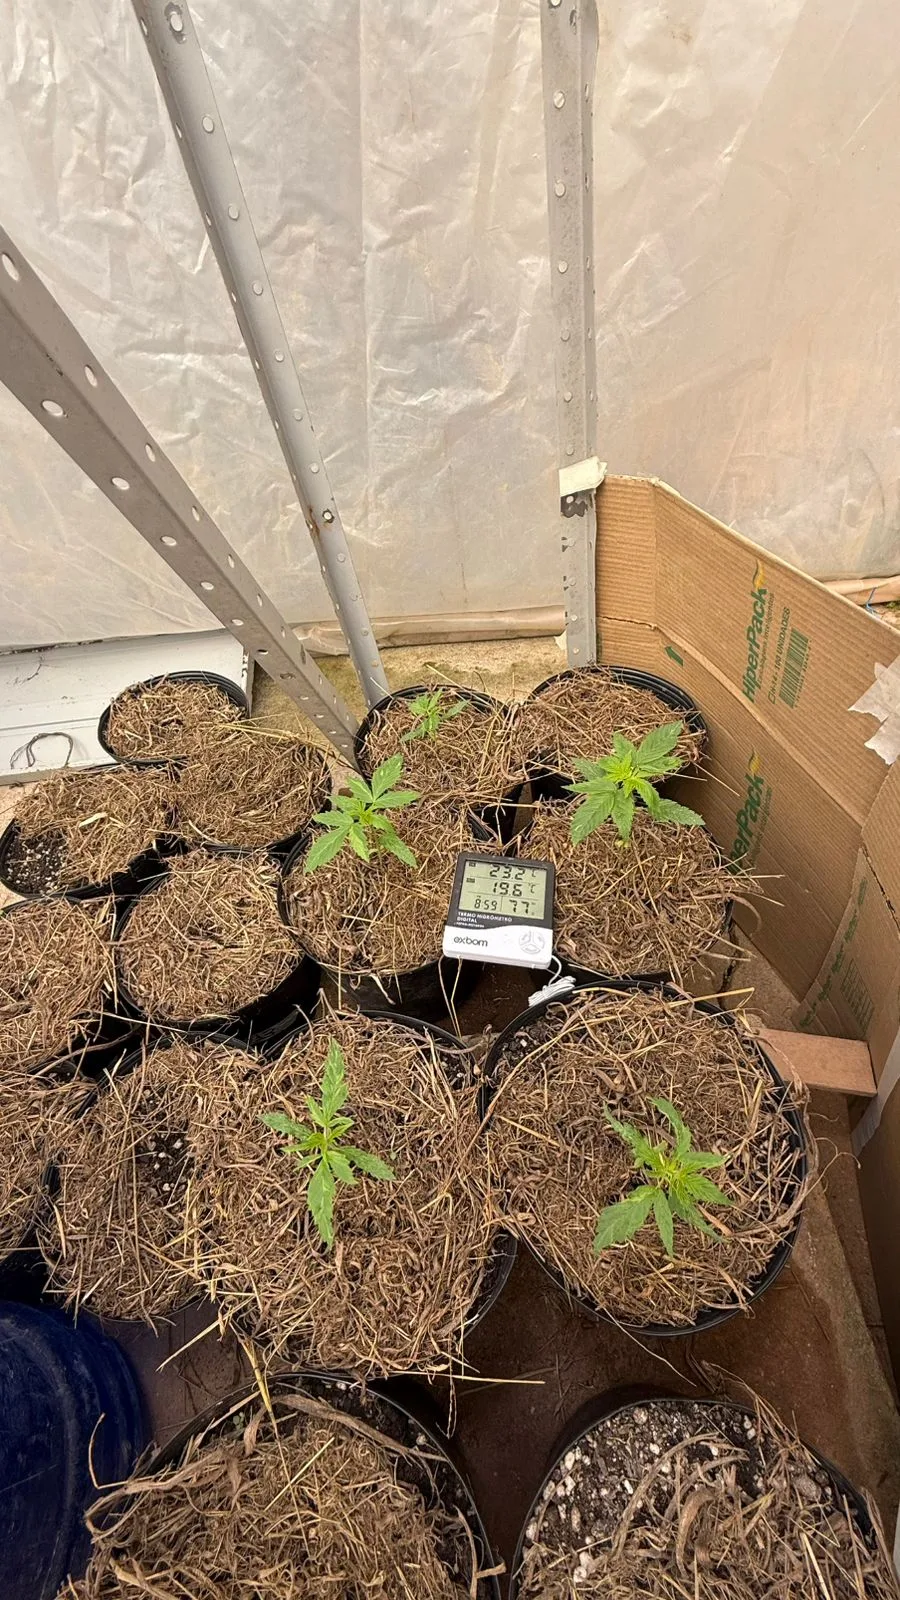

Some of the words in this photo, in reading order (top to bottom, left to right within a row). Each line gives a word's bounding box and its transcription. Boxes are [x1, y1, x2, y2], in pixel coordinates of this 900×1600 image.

[776, 606, 790, 655] UNIDADES
[742, 588, 767, 703] HiperPack
[489, 864, 526, 881] 23.2
[493, 882, 523, 897] 19.6
[453, 936, 489, 947] exbom
